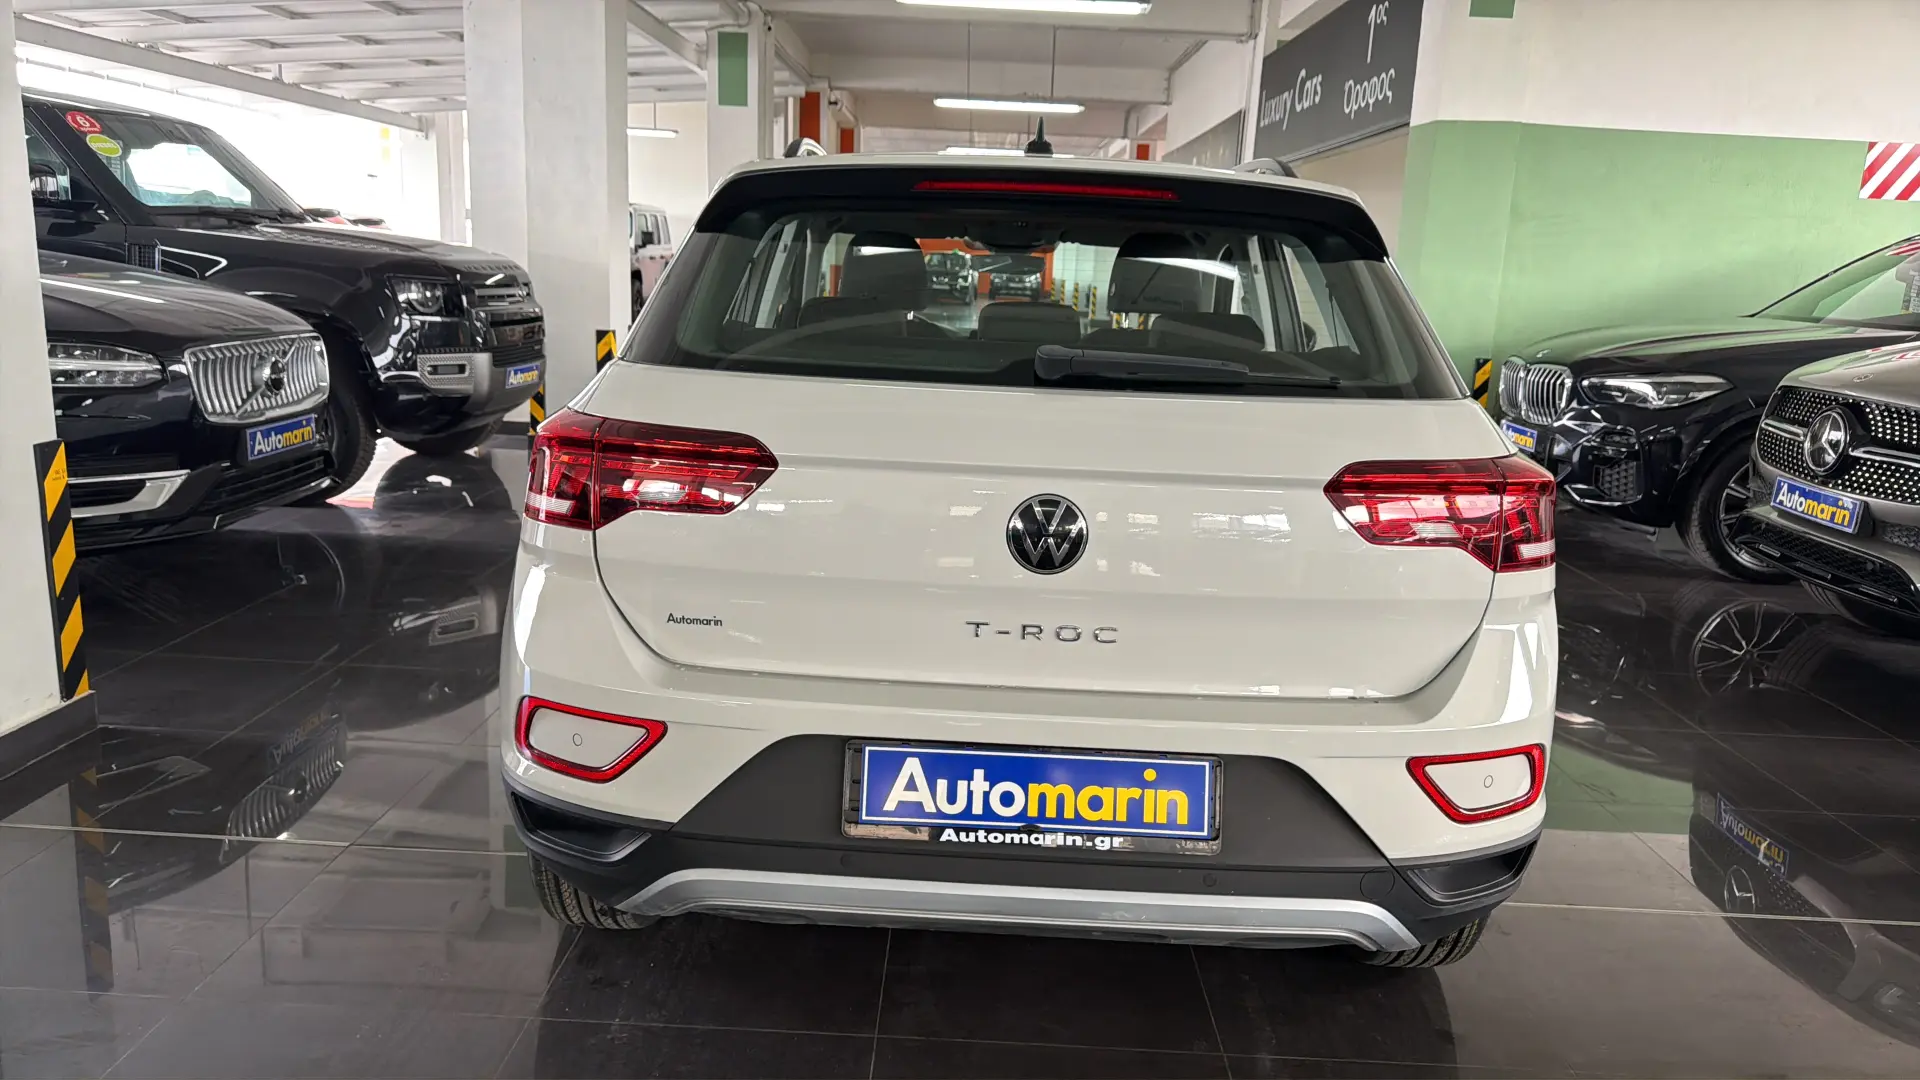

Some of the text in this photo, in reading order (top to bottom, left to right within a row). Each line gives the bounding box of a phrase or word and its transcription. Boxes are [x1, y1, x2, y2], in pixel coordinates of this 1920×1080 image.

[1260, 68, 1322, 131] Luxury Cars
[75, 114, 91, 127] 6
[508, 365, 539, 385] Automarin
[254, 420, 312, 455] Automarin
[1776, 483, 1851, 526] Automarin
[666, 612, 723, 627] Automarin
[965, 621, 1119, 644] T-ROC
[883, 756, 1188, 825] Automarin
[939, 828, 1124, 850] Automarin.gr
